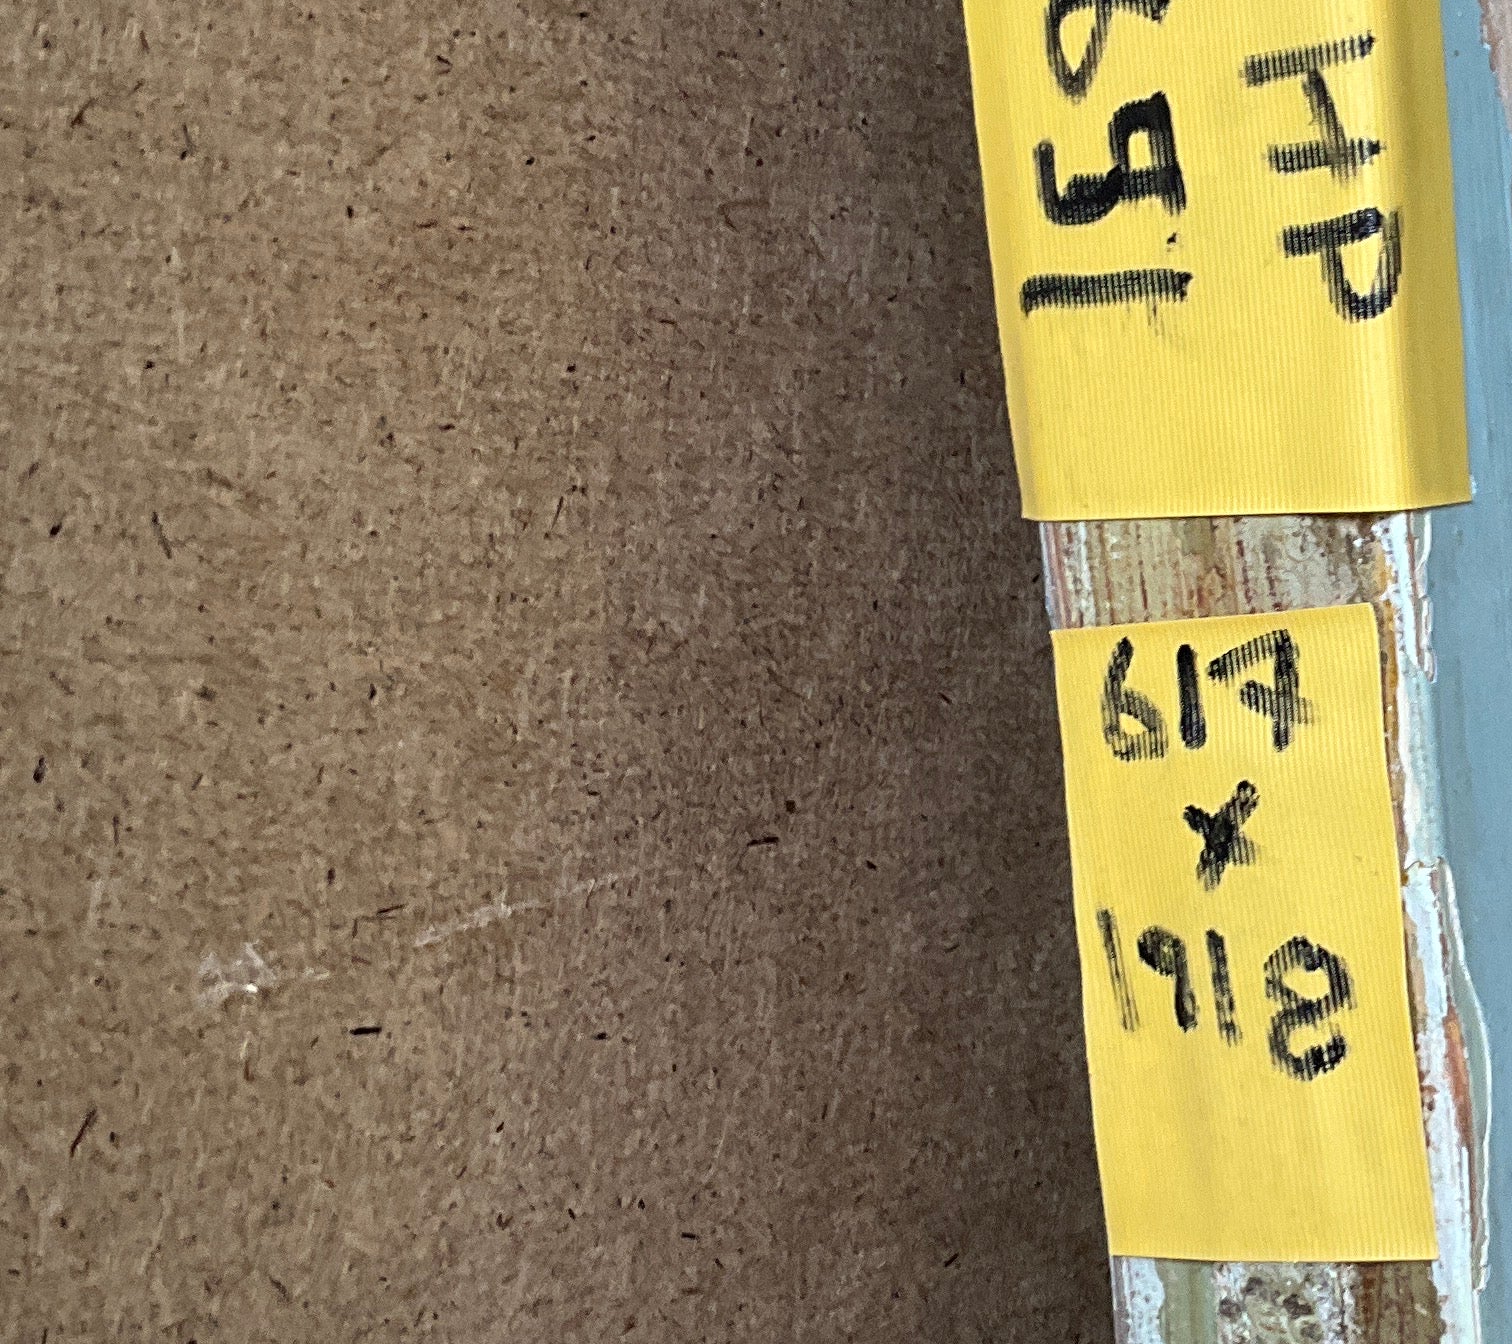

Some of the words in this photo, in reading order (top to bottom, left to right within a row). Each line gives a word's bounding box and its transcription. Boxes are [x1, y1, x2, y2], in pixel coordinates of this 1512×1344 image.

[1243, 31, 1403, 323] HP
[1100, 628, 1316, 762] 617
[1097, 908, 1356, 1081] 1918
